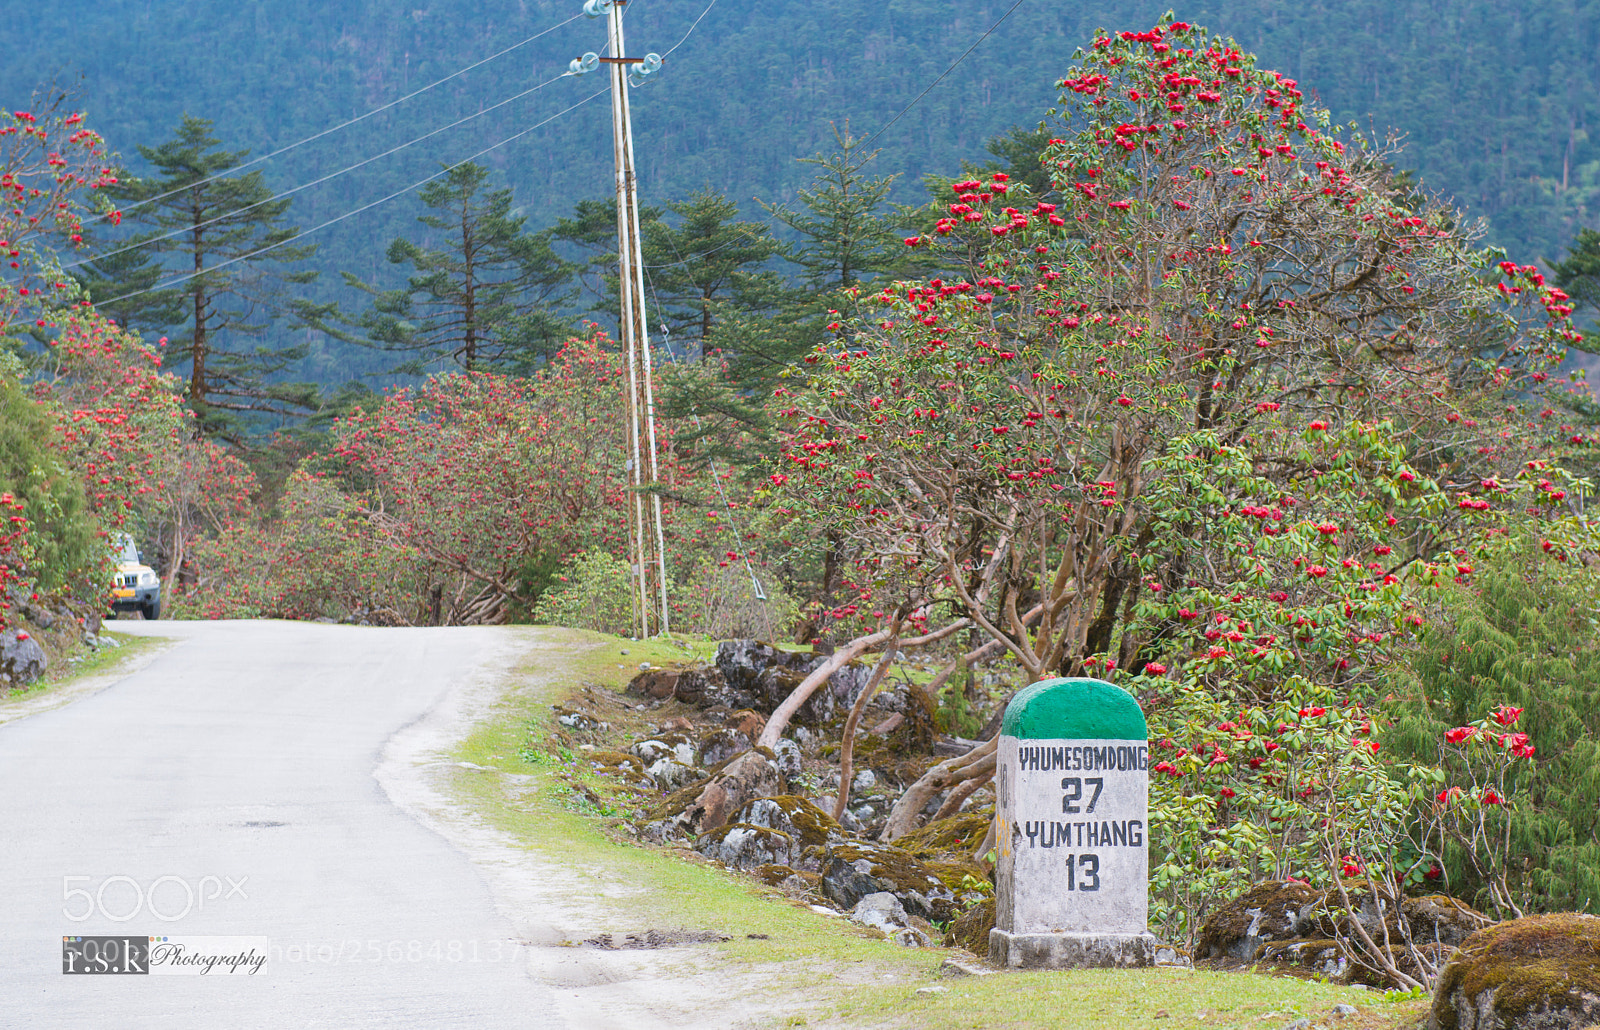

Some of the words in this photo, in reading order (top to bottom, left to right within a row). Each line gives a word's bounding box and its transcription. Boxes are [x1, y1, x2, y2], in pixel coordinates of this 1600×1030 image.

[1019, 746, 1147, 771] YHUMESOMDONG
[1061, 777, 1103, 813] 27
[1025, 820, 1142, 848] YUMTHANG
[1066, 854, 1100, 891] 13
